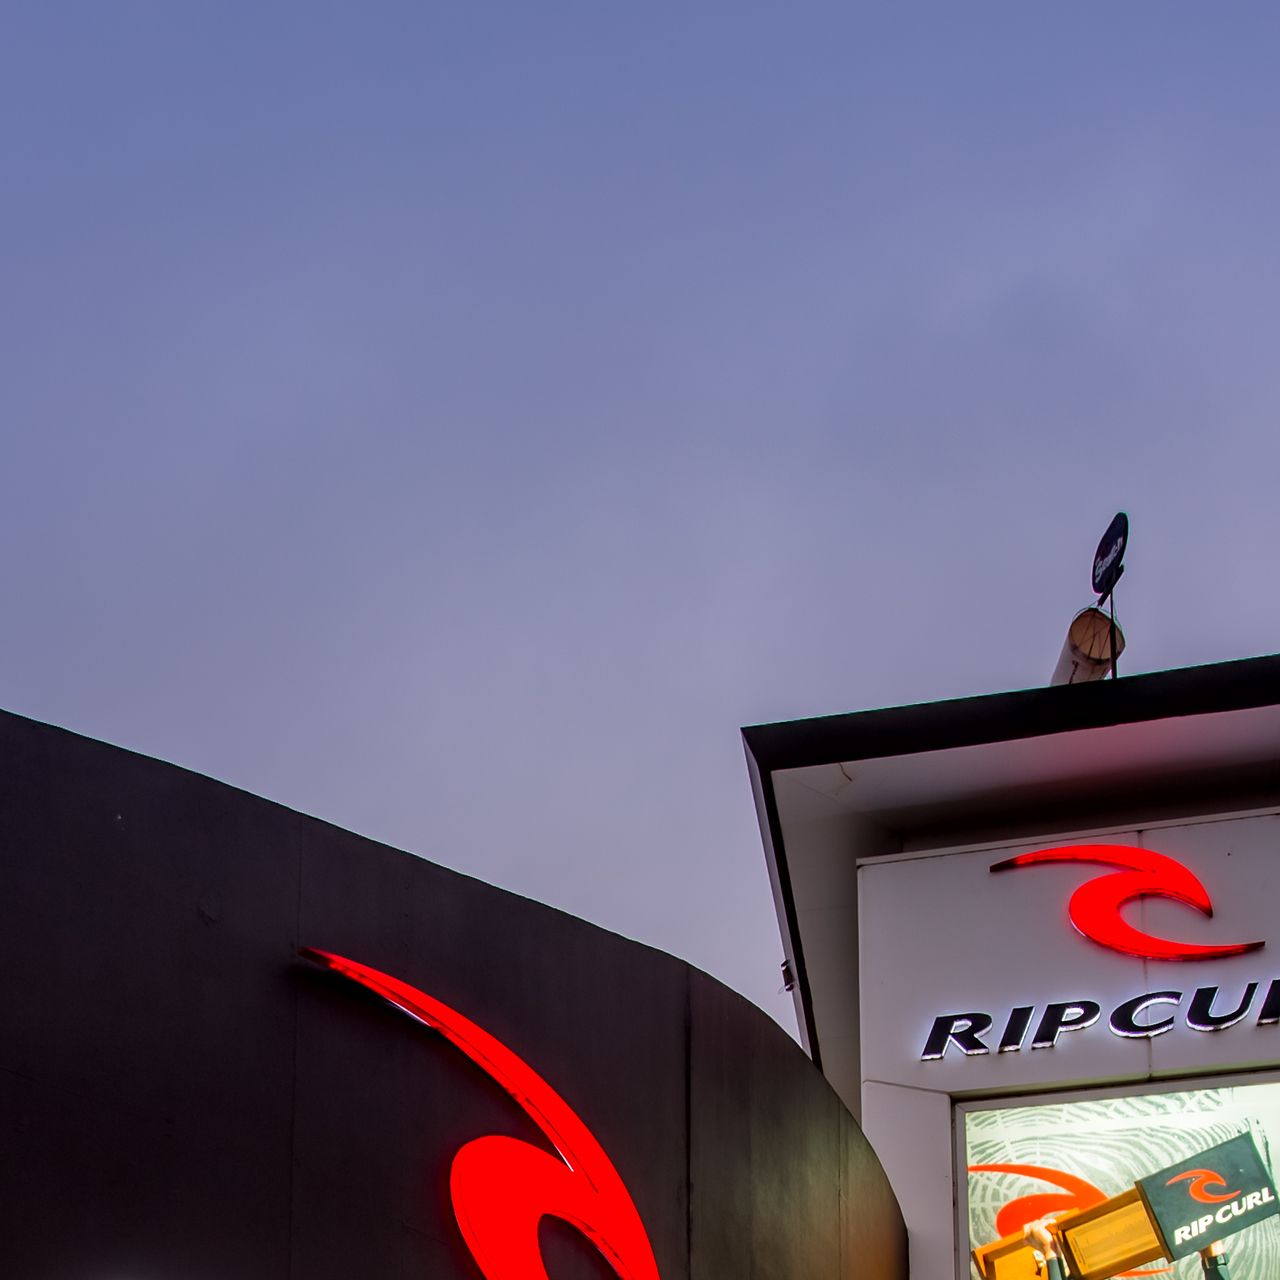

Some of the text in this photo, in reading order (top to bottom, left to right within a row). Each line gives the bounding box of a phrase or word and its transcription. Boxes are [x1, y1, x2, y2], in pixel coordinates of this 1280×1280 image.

[920, 1000, 1100, 1060] RIP
[1174, 1187, 1275, 1246] RIP CURL
